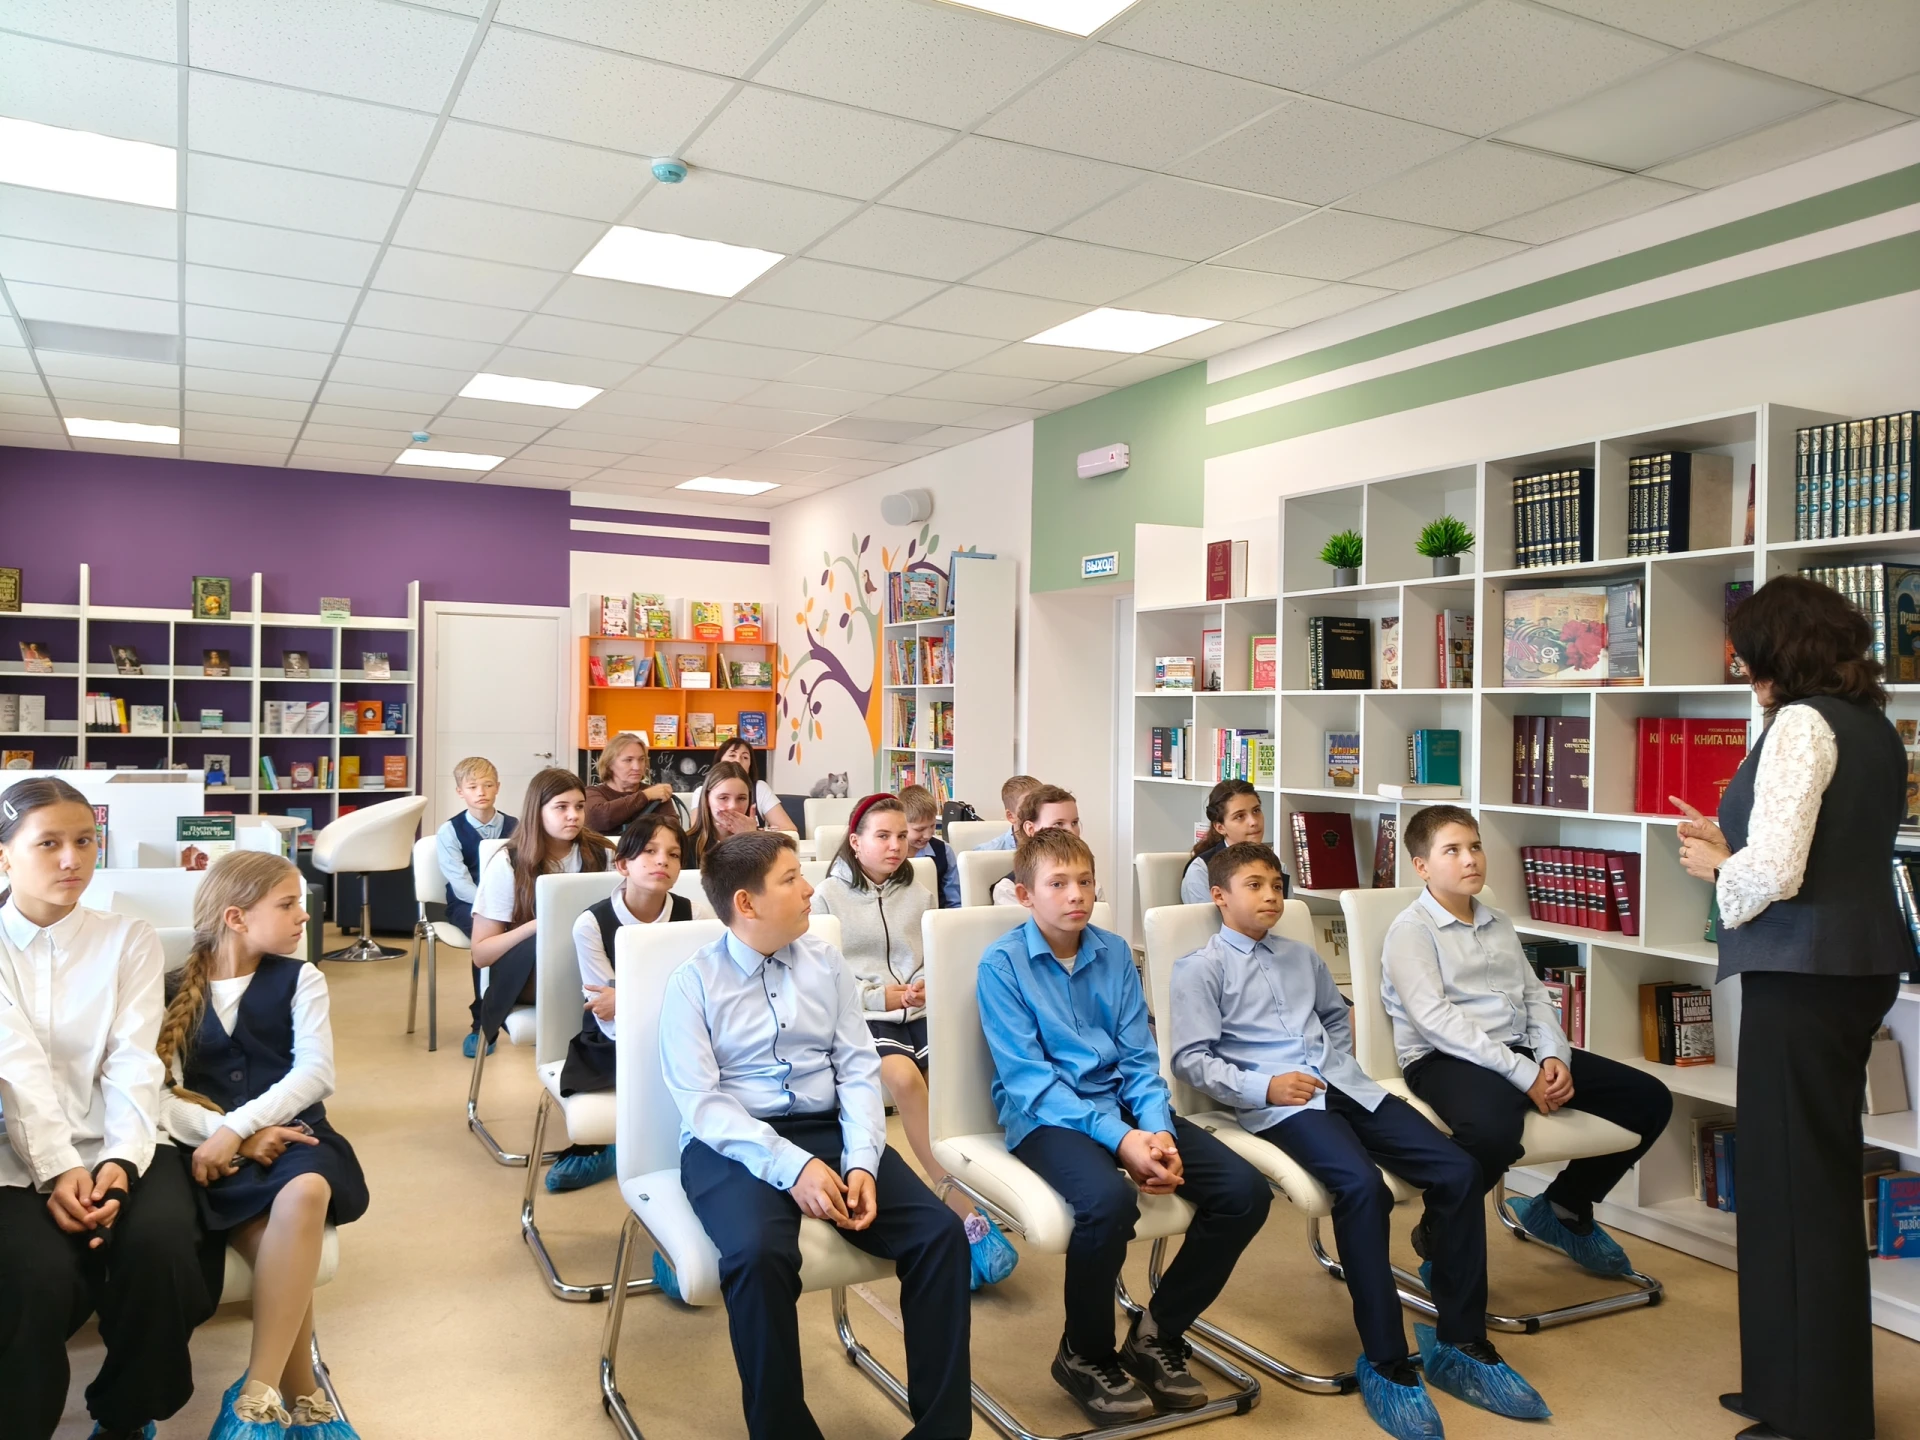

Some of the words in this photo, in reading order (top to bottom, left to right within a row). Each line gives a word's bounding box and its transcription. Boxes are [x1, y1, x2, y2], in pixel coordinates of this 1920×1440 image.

[1086, 558, 1113, 572] ВЫХОД
[1331, 669, 1365, 679] МИФОЛОГИЯ
[1694, 734, 1723, 745] КНИГА
[1725, 734, 1745, 745] ПАМ
[1682, 995, 1711, 1007] РУССКАЯ
